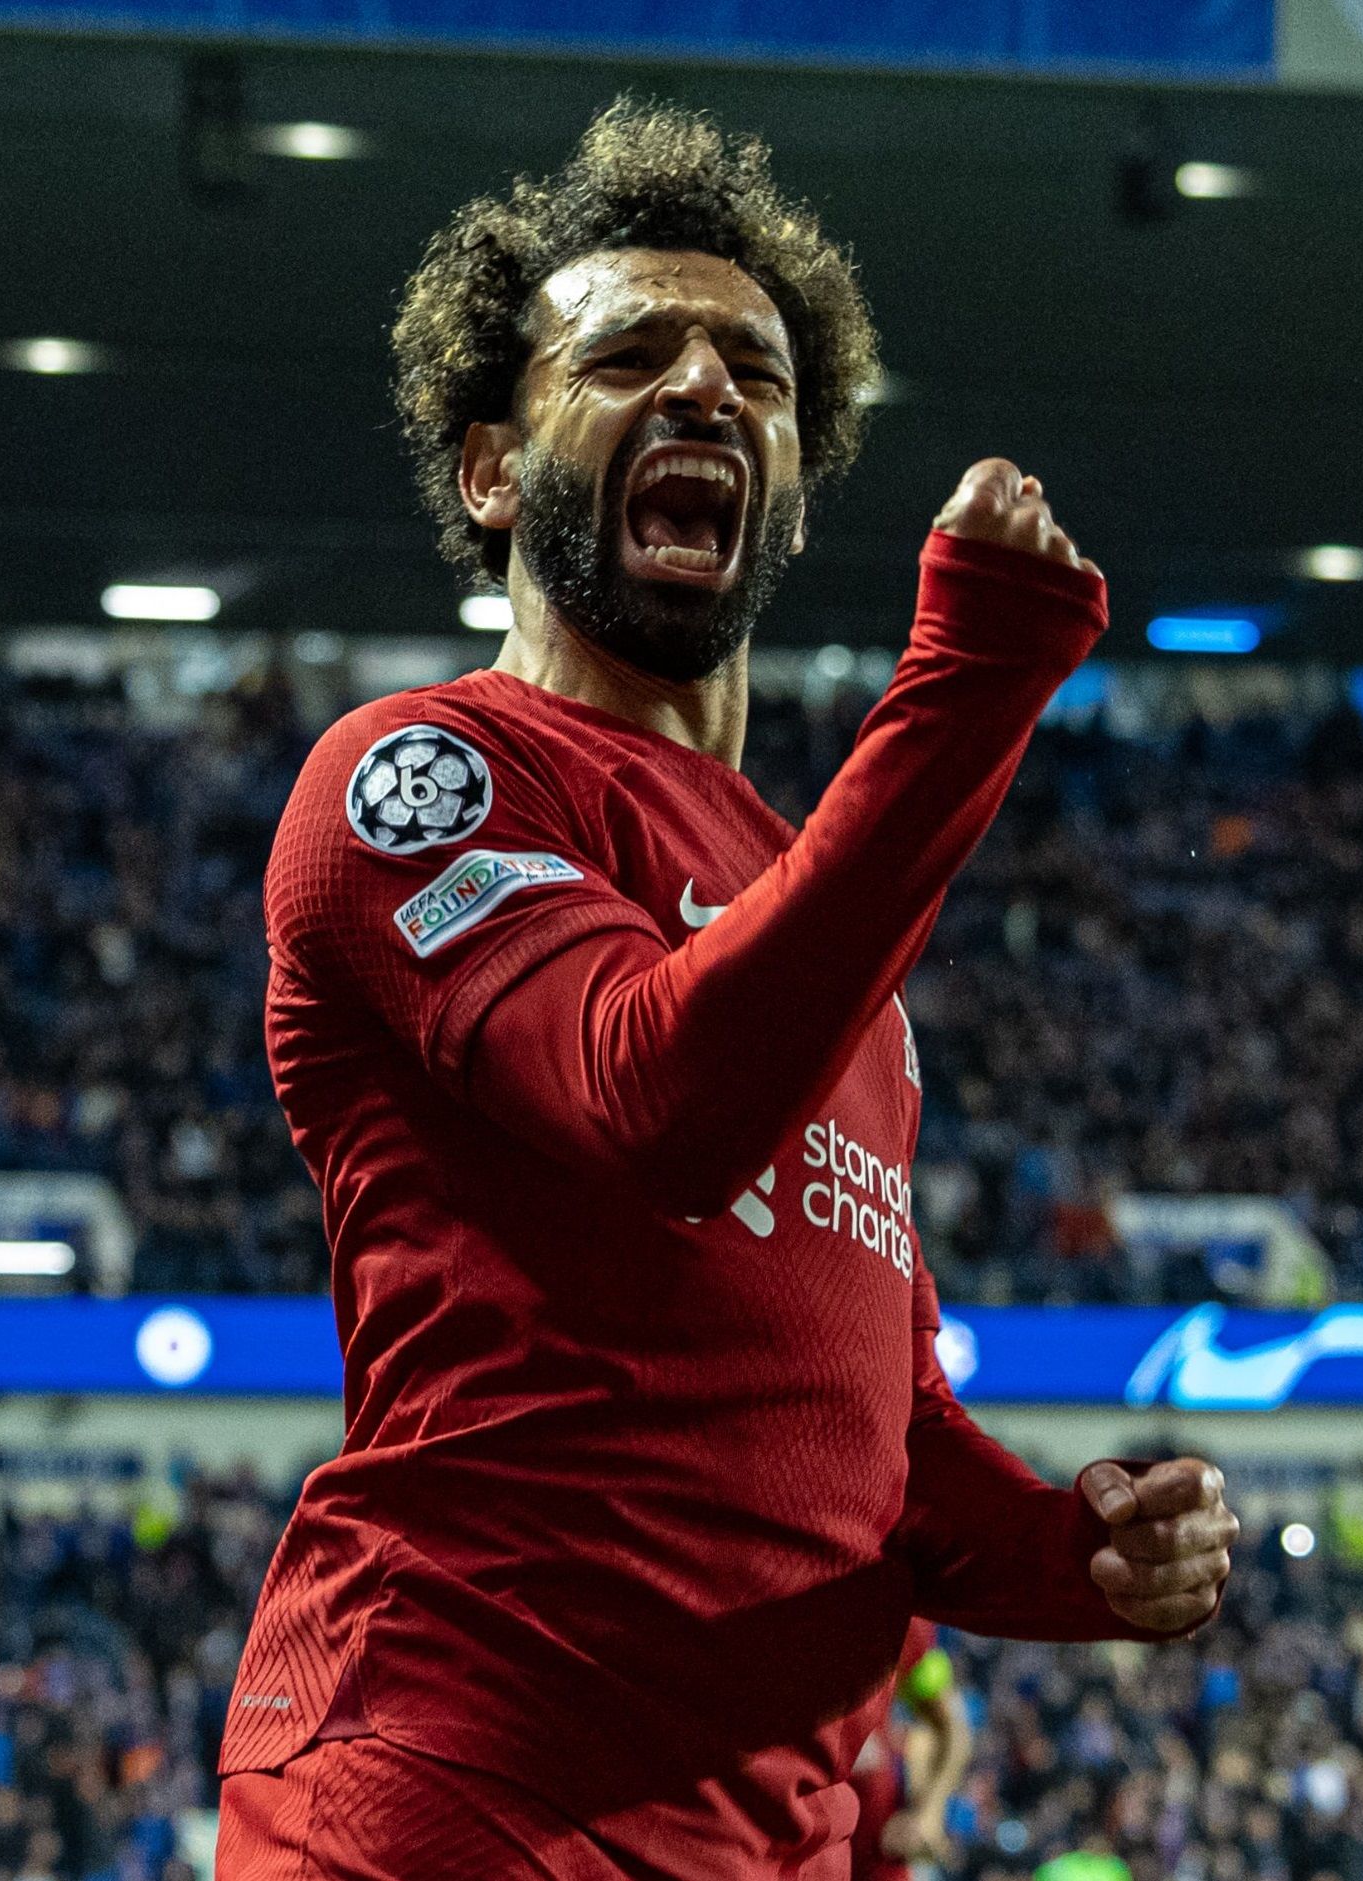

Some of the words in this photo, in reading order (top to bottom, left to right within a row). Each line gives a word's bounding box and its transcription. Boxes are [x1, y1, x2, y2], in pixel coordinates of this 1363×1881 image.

[400, 766, 437, 807] 6
[400, 891, 437, 923] UEFA
[407, 859, 568, 939] FOUNDATION
[802, 1177, 913, 1282] charte
